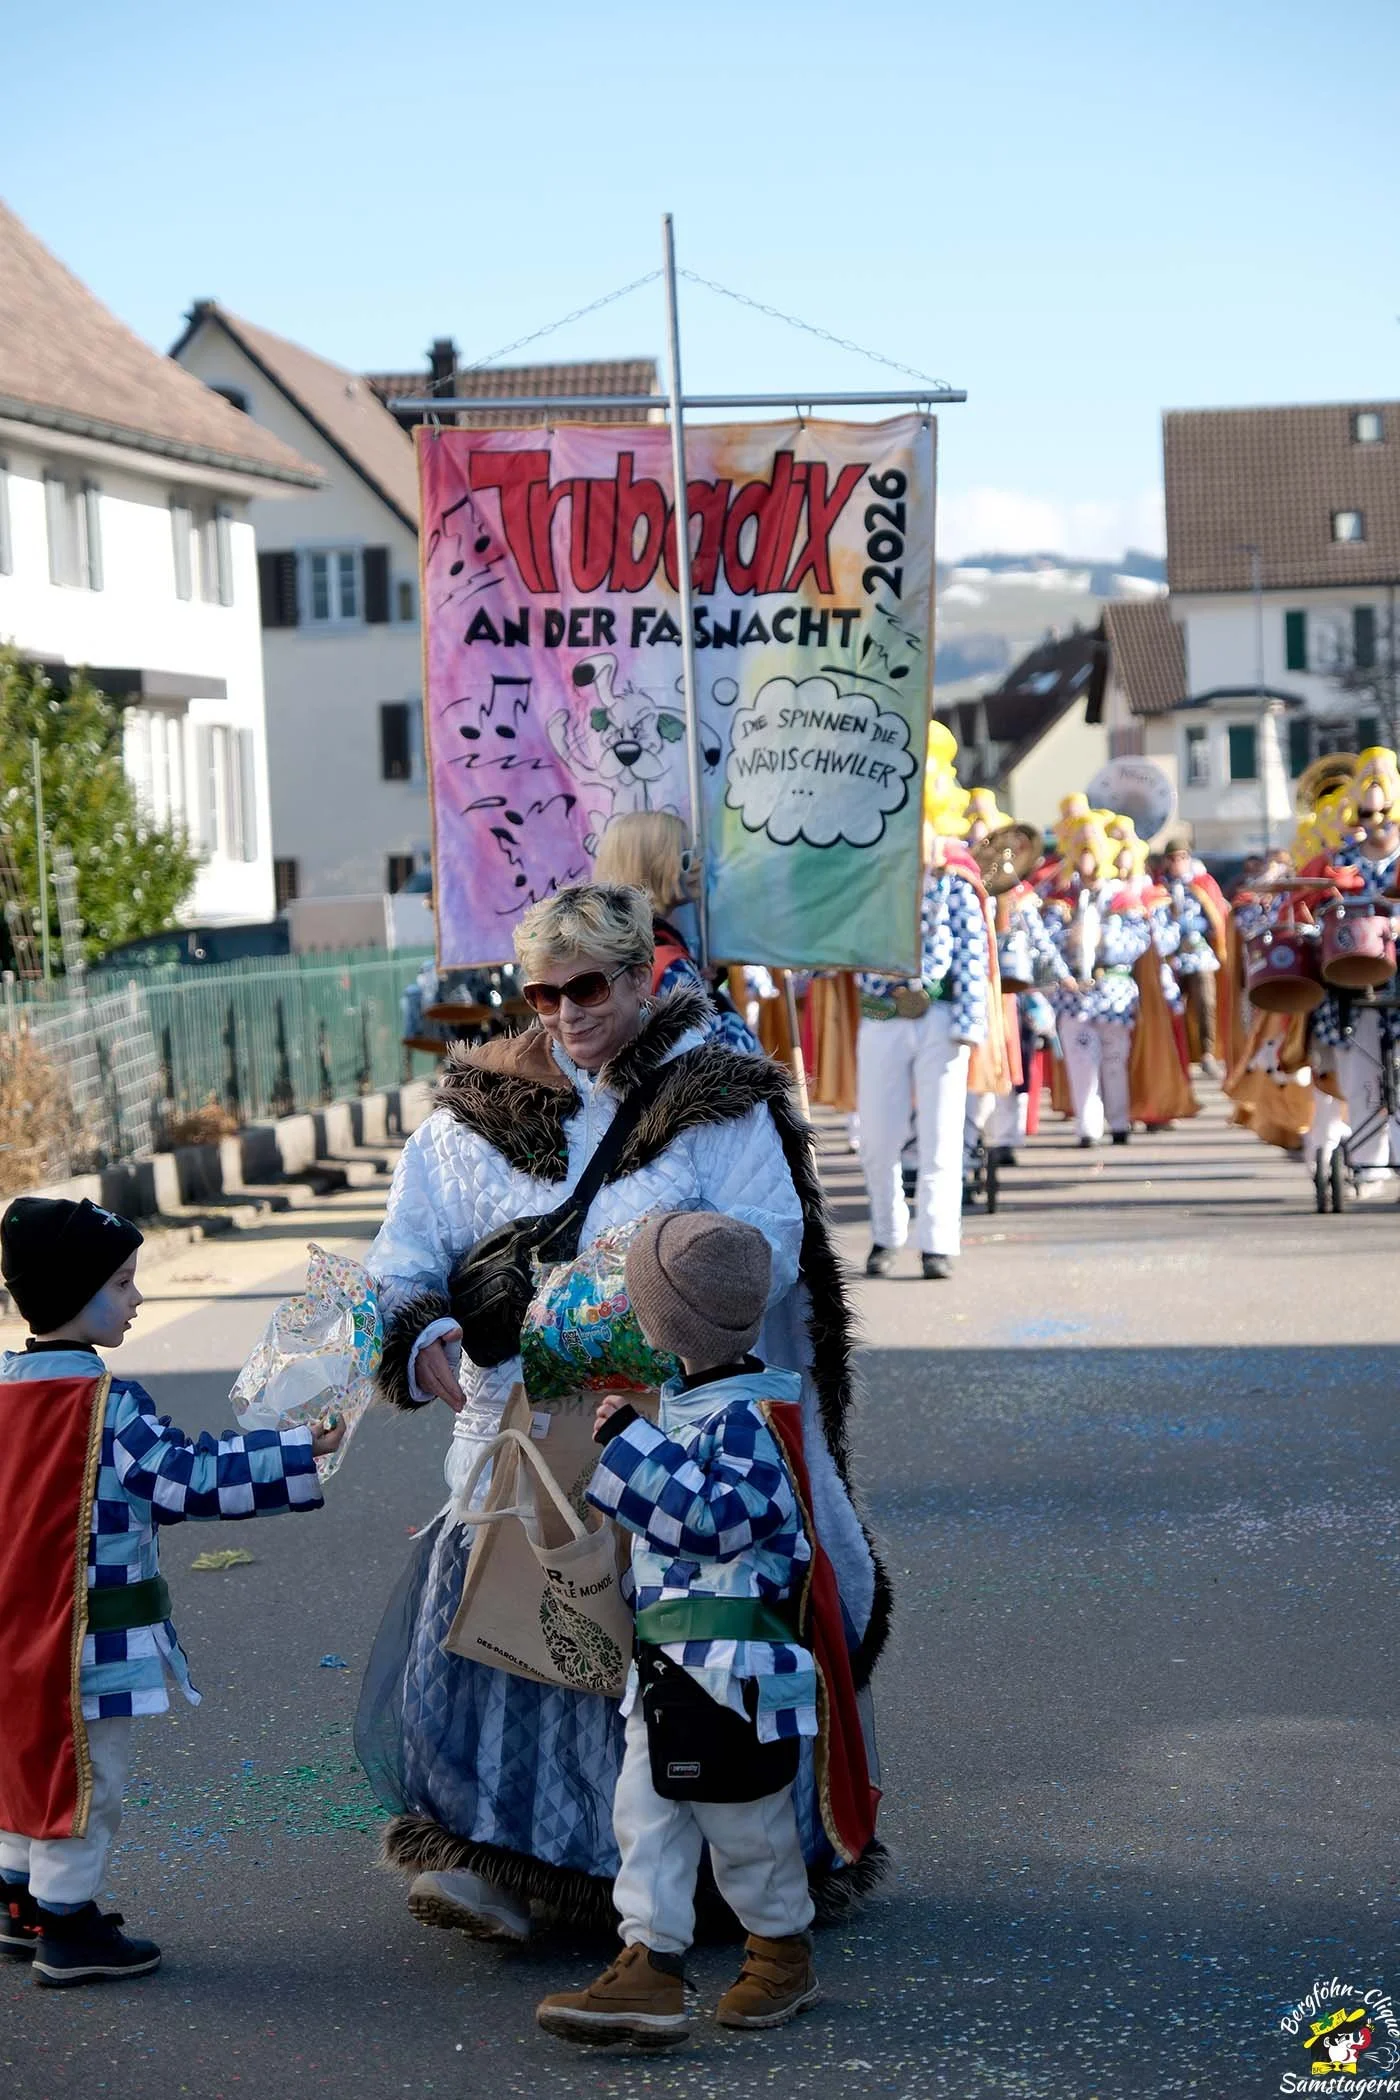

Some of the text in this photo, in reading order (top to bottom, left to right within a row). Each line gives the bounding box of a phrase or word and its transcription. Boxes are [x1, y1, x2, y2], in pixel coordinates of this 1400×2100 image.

[862, 468, 908, 600] 2026
[464, 605, 861, 649] AN DER FASNACHT
[741, 708, 899, 745] DIE SPINNEN DIE
[736, 746, 897, 788] WÄDISCHWILER
[565, 1589, 577, 1599] LE
[580, 1573, 615, 1598] MONDE
